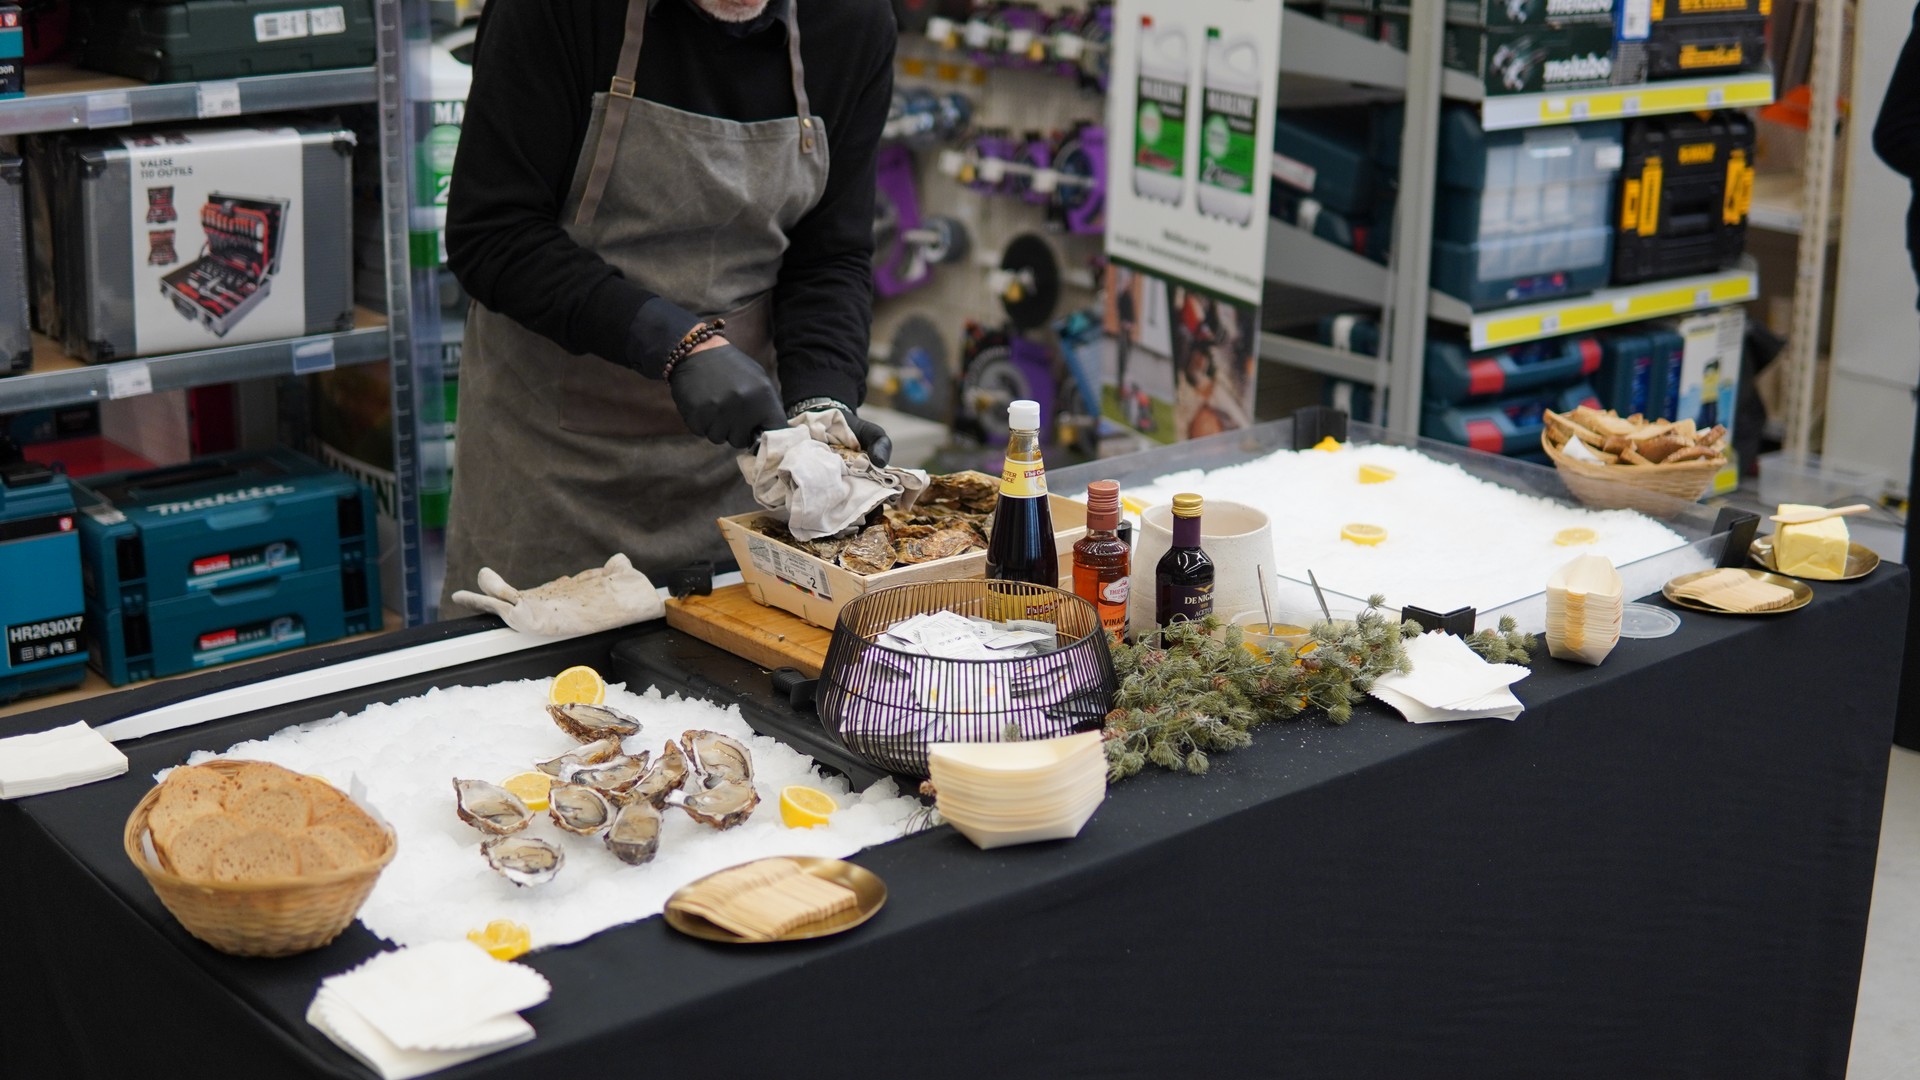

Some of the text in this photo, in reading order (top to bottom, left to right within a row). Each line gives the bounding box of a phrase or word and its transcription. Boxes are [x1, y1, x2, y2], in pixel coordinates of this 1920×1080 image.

[140, 158, 173, 168] VALISE
[157, 166, 193, 178] OUTILS
[1184, 596, 1198, 604] DE
[10, 616, 84, 643] HR2630X7
